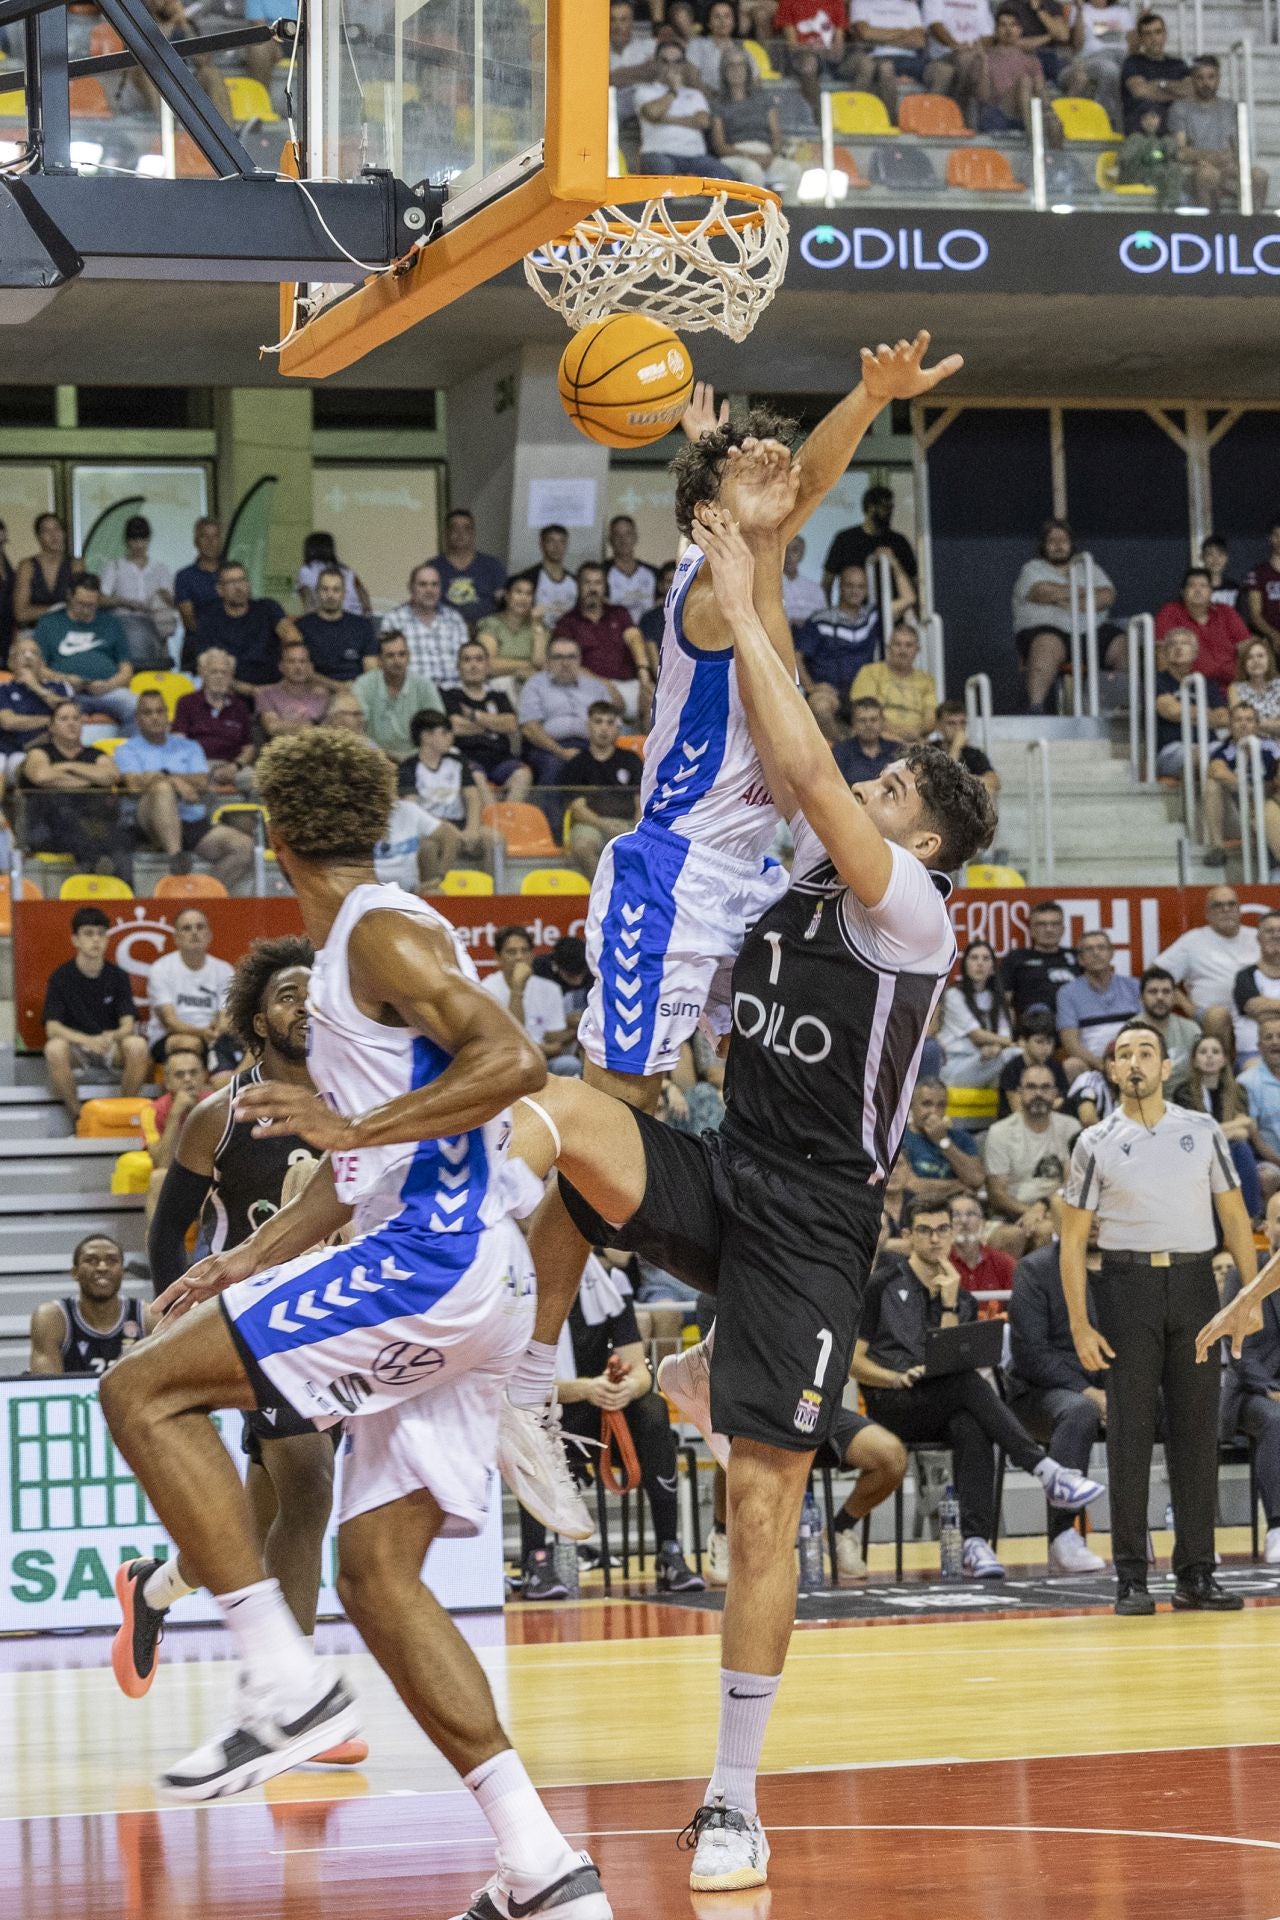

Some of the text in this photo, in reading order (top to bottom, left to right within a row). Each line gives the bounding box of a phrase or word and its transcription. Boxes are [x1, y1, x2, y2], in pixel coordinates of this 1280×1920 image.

[800, 226, 989, 271] ODILO
[763, 931, 783, 985] 1
[950, 901, 1033, 958] EROS
[734, 991, 832, 1064] DILO
[813, 1328, 833, 1389] 1
